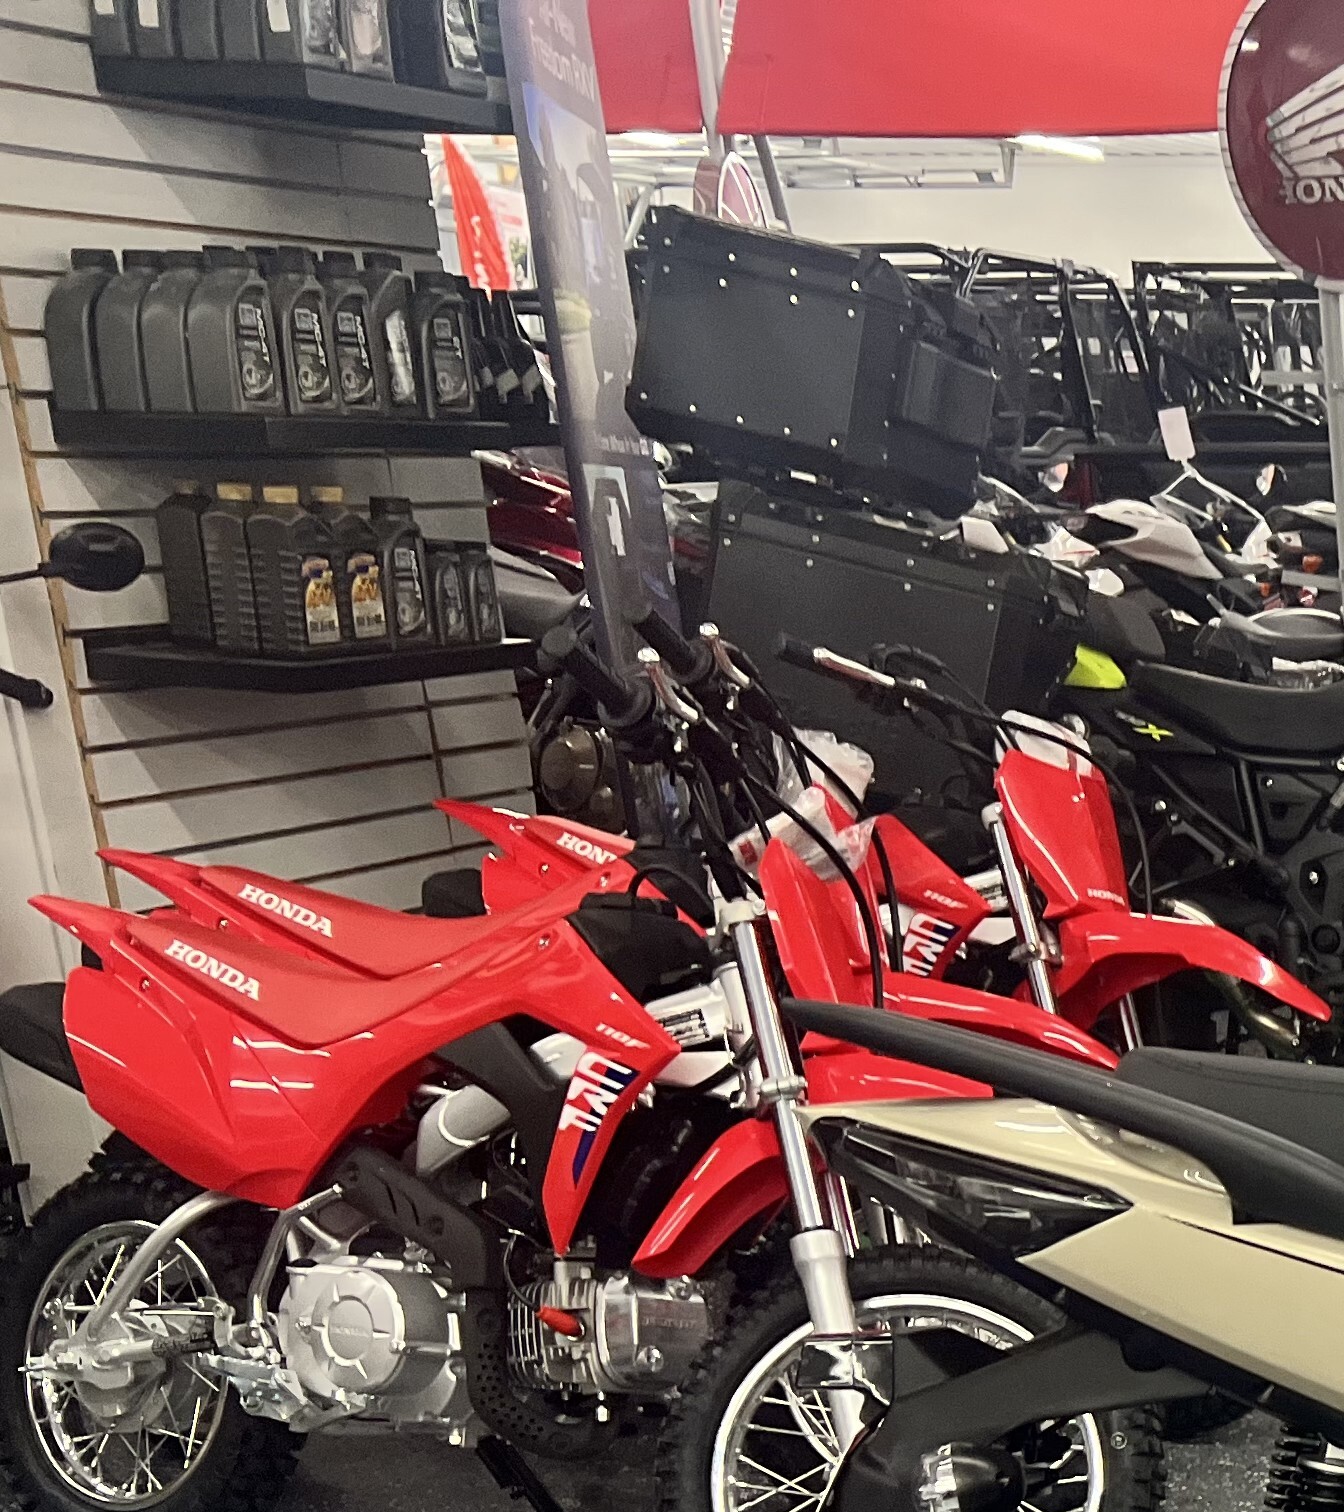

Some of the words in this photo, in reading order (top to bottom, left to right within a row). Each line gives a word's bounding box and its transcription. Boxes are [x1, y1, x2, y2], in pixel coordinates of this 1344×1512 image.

[556, 832, 618, 865] HON
[237, 883, 333, 938] HONDA
[164, 939, 260, 1001] HONDA
[558, 1051, 634, 1132] CRF
